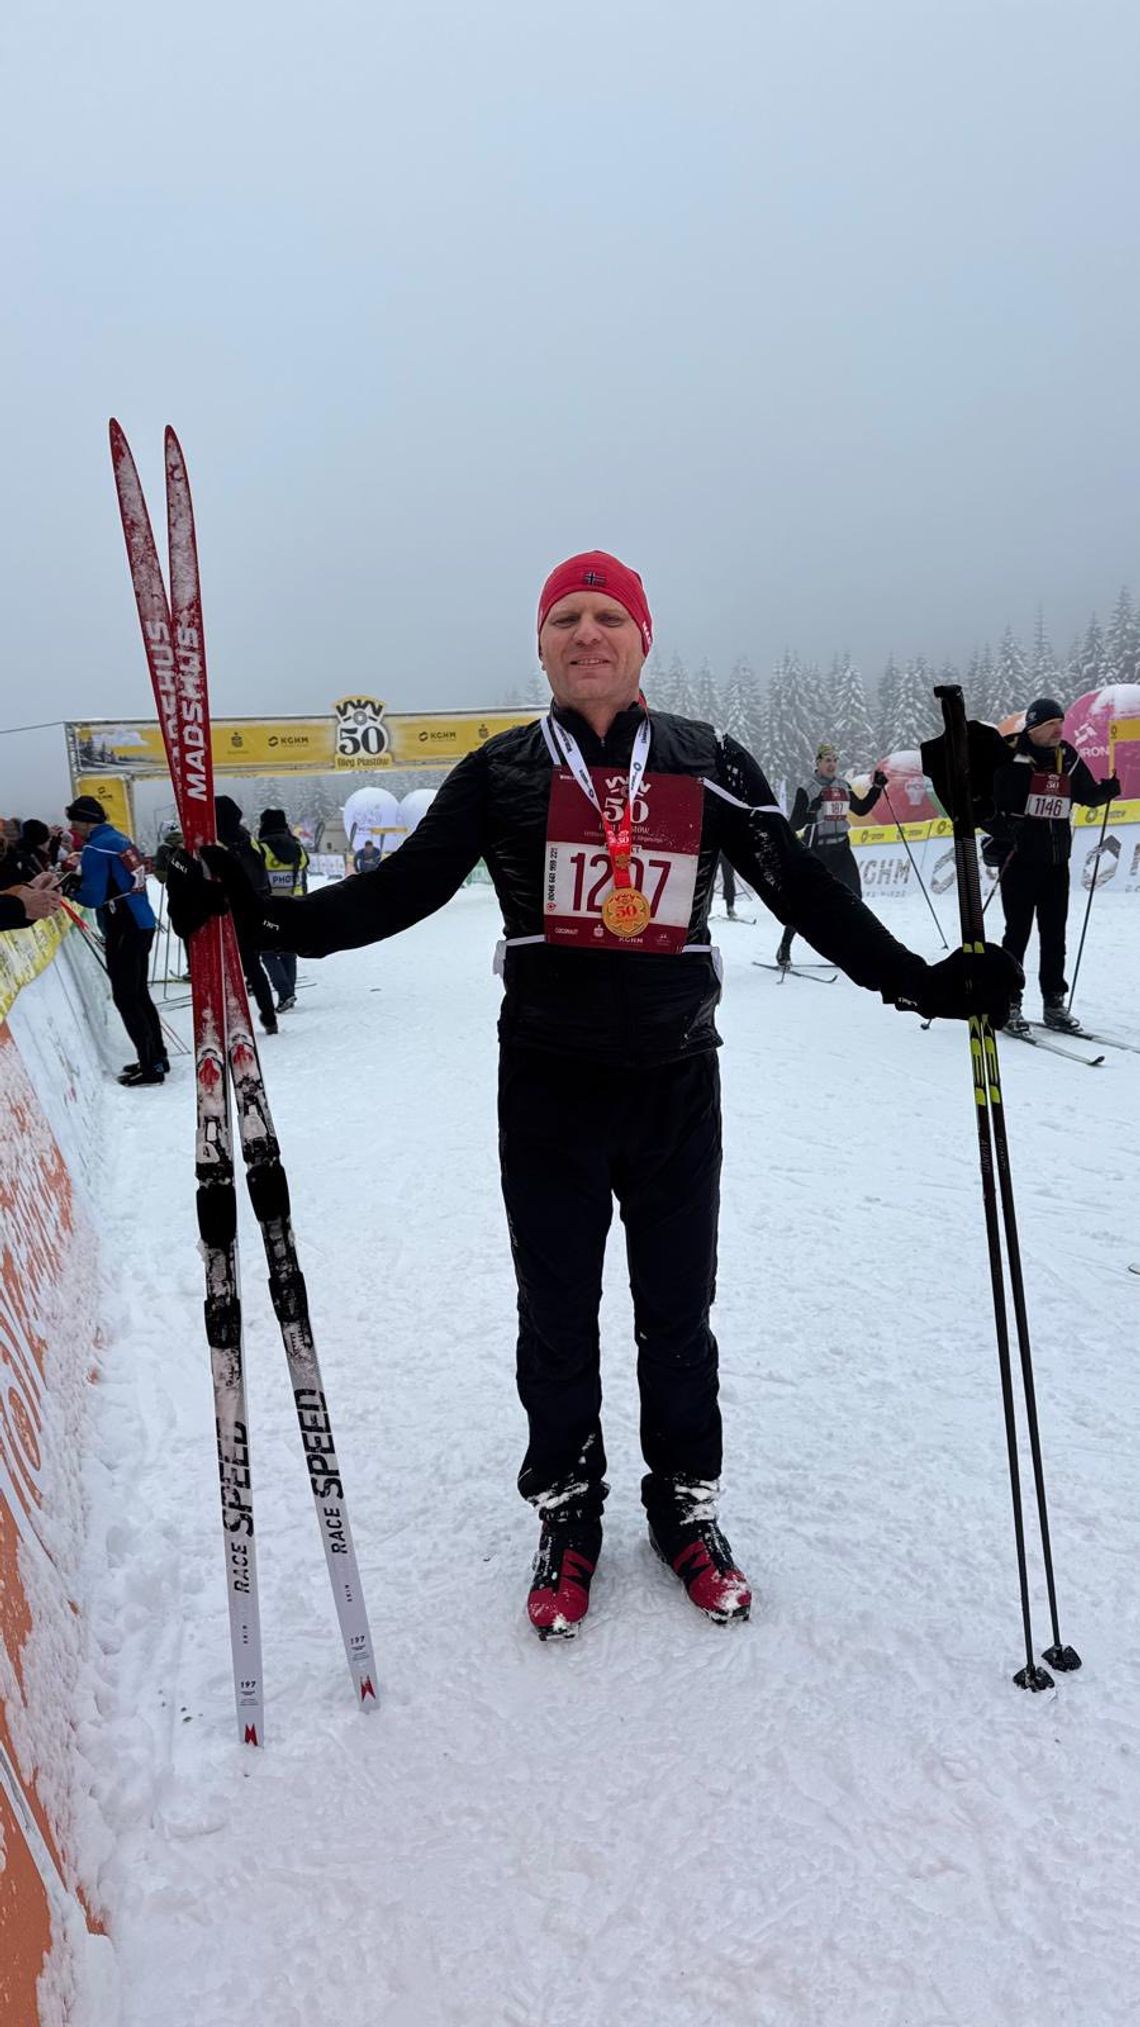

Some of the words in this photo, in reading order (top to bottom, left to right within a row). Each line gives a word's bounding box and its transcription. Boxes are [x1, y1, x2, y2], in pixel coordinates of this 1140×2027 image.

[177, 624, 208, 802] MADSHUS
[280, 736, 309, 745] KGHM
[339, 725, 386, 756] 50
[604, 797, 649, 823] 50
[1034, 797, 1063, 817] 1146
[858, 857, 911, 886] GHM
[294, 1388, 344, 1500] SPEED
[324, 1507, 348, 1554] RACE
[231, 1542, 250, 1594] RACE
[240, 1680, 257, 1689] 197
